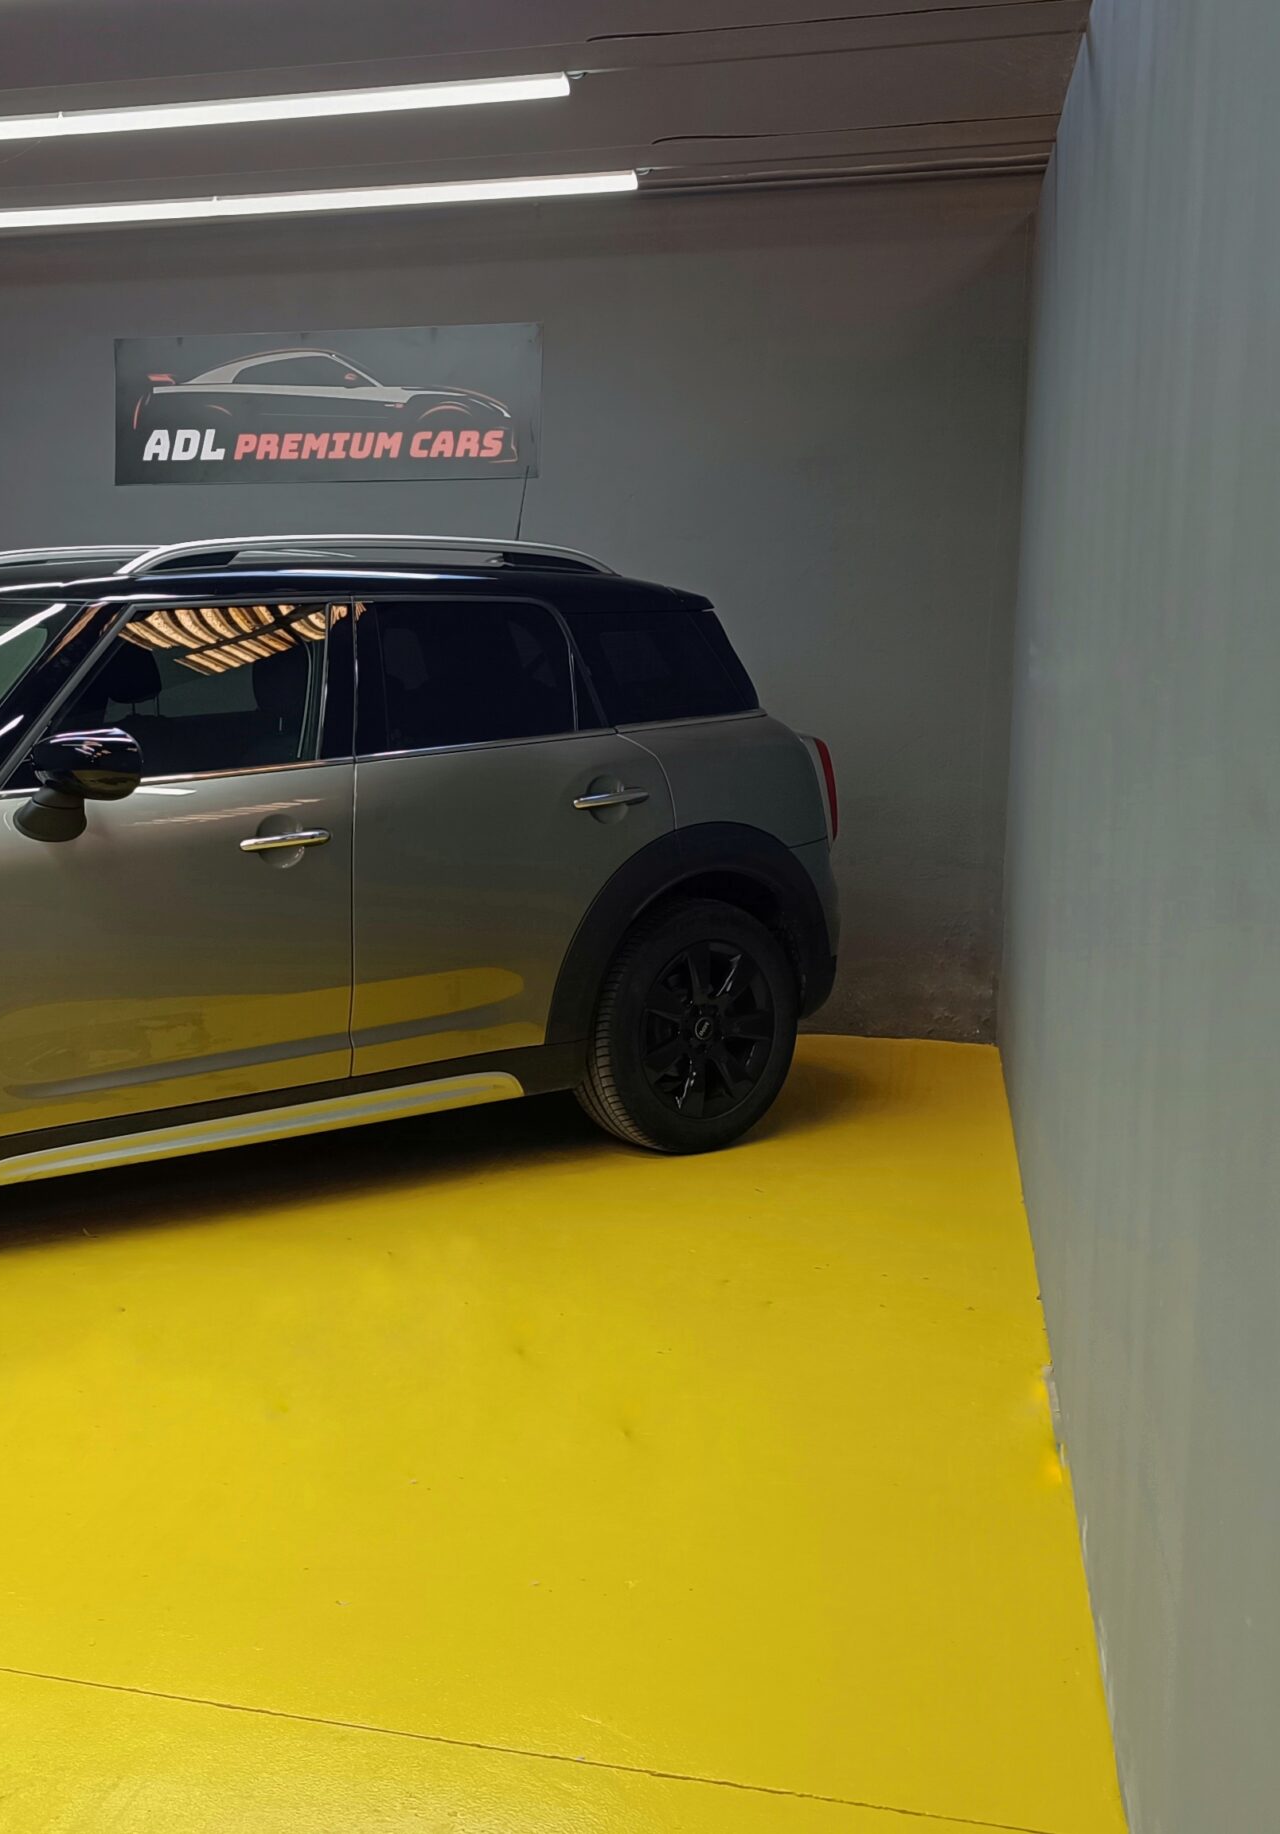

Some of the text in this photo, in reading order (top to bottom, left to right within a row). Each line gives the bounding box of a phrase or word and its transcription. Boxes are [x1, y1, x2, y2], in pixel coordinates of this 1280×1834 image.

[143, 429, 504, 461] ADL PREMIUM CARS
